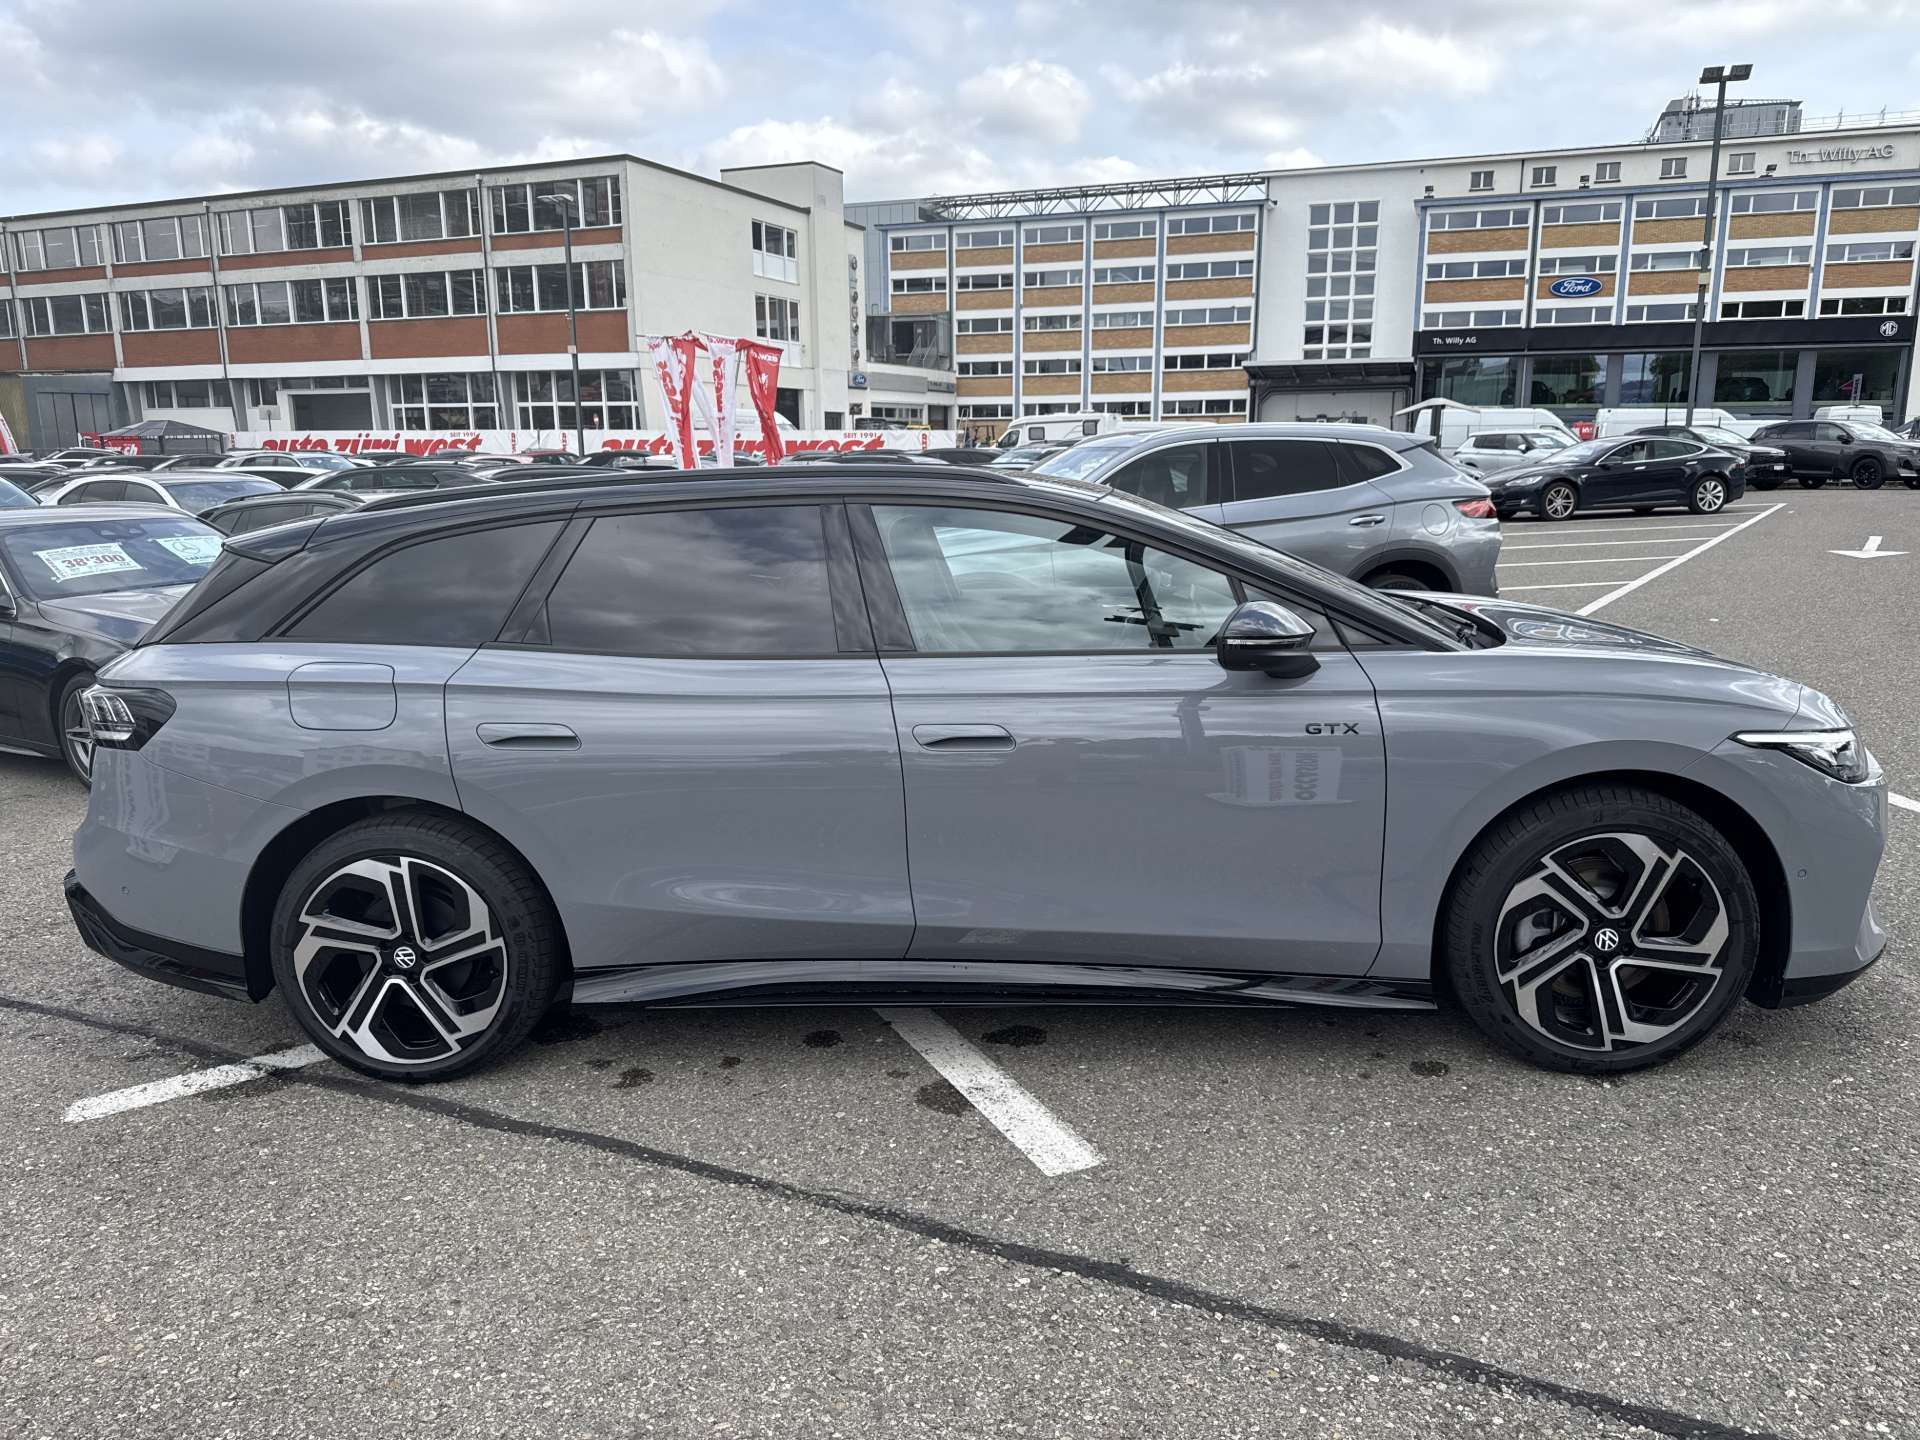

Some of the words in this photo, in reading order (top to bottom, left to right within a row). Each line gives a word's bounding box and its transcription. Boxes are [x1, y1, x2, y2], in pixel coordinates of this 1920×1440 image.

[1820, 145, 1861, 164] Willy
[1868, 143, 1896, 158] AG
[1881, 321, 1898, 336] MG
[1432, 337, 1444, 345] Th.
[1445, 337, 1463, 346] Willy
[1465, 336, 1477, 344] AG
[61, 552, 125, 569] 38'300
[1304, 722, 1360, 735] GTX
